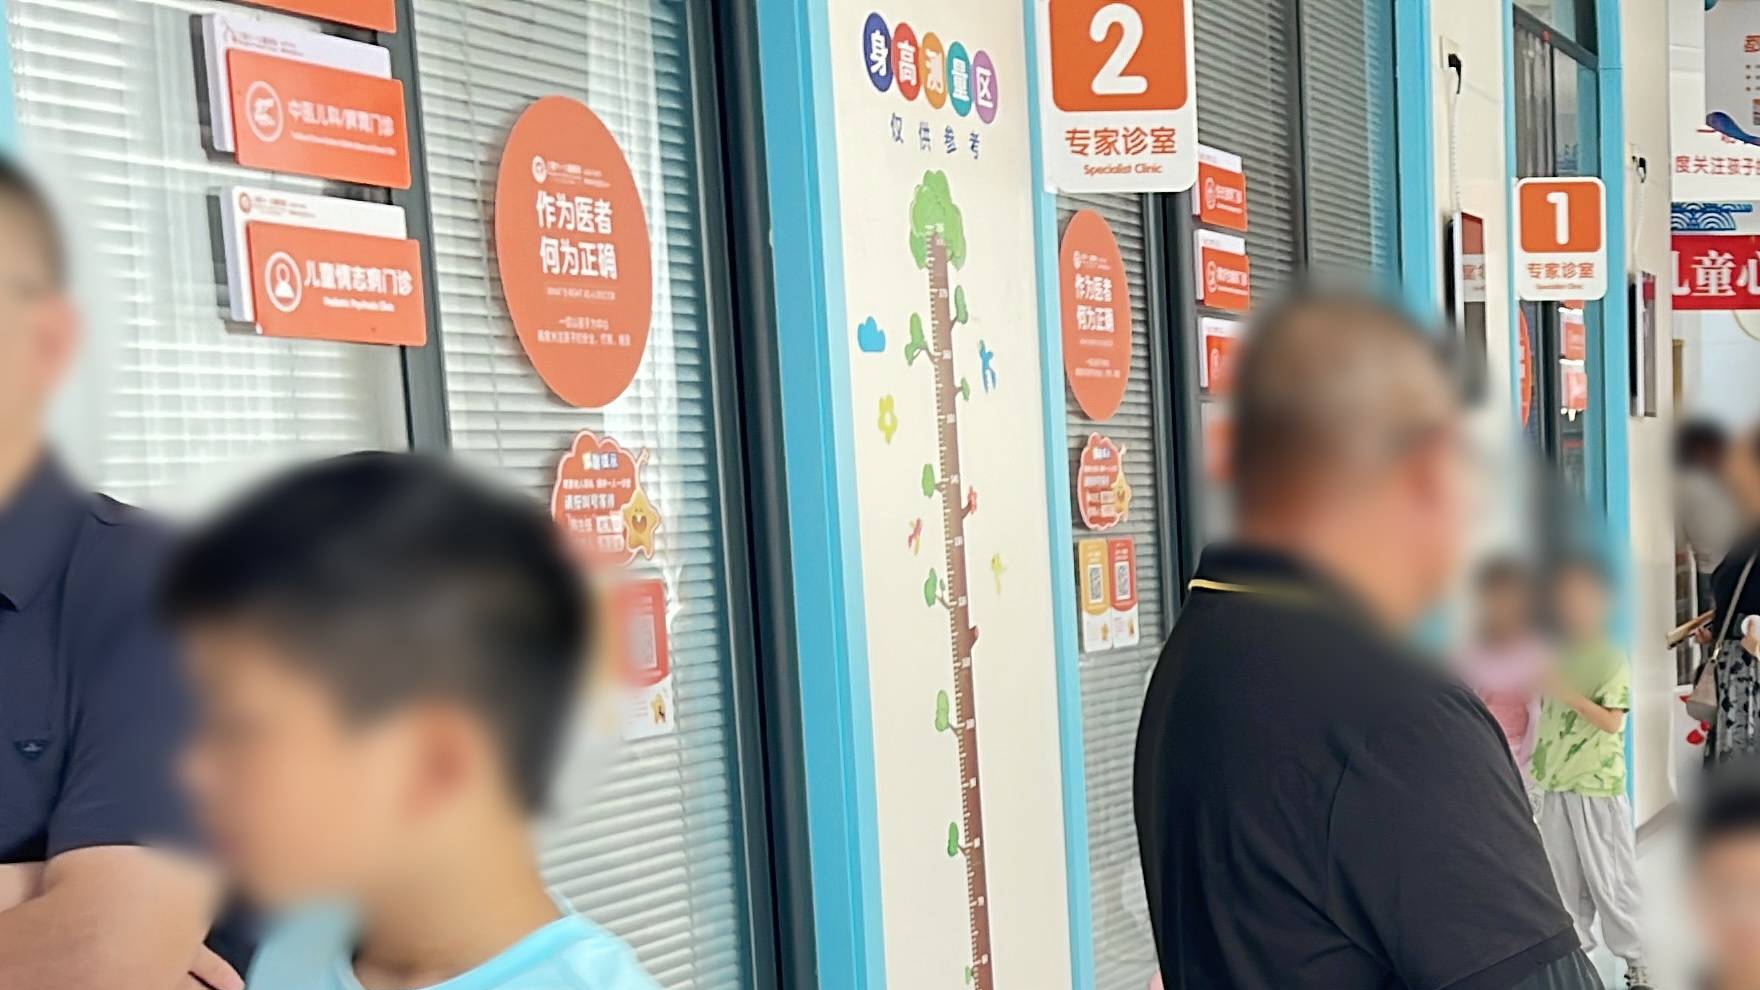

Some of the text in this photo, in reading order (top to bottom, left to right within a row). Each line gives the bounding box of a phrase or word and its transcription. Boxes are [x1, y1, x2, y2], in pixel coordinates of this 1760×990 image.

[870, 30, 994, 108] 身高测量区
[1089, 3, 1148, 95] 2
[891, 112, 980, 160] 仅供参考
[1065, 126, 1177, 156] 专家诊室
[1135, 163, 1163, 174] Clinic
[536, 189, 613, 235] 作为医者
[1546, 191, 1569, 245] 1
[539, 235, 618, 280] 何为正确
[1527, 262, 1594, 279] 专家诊室
